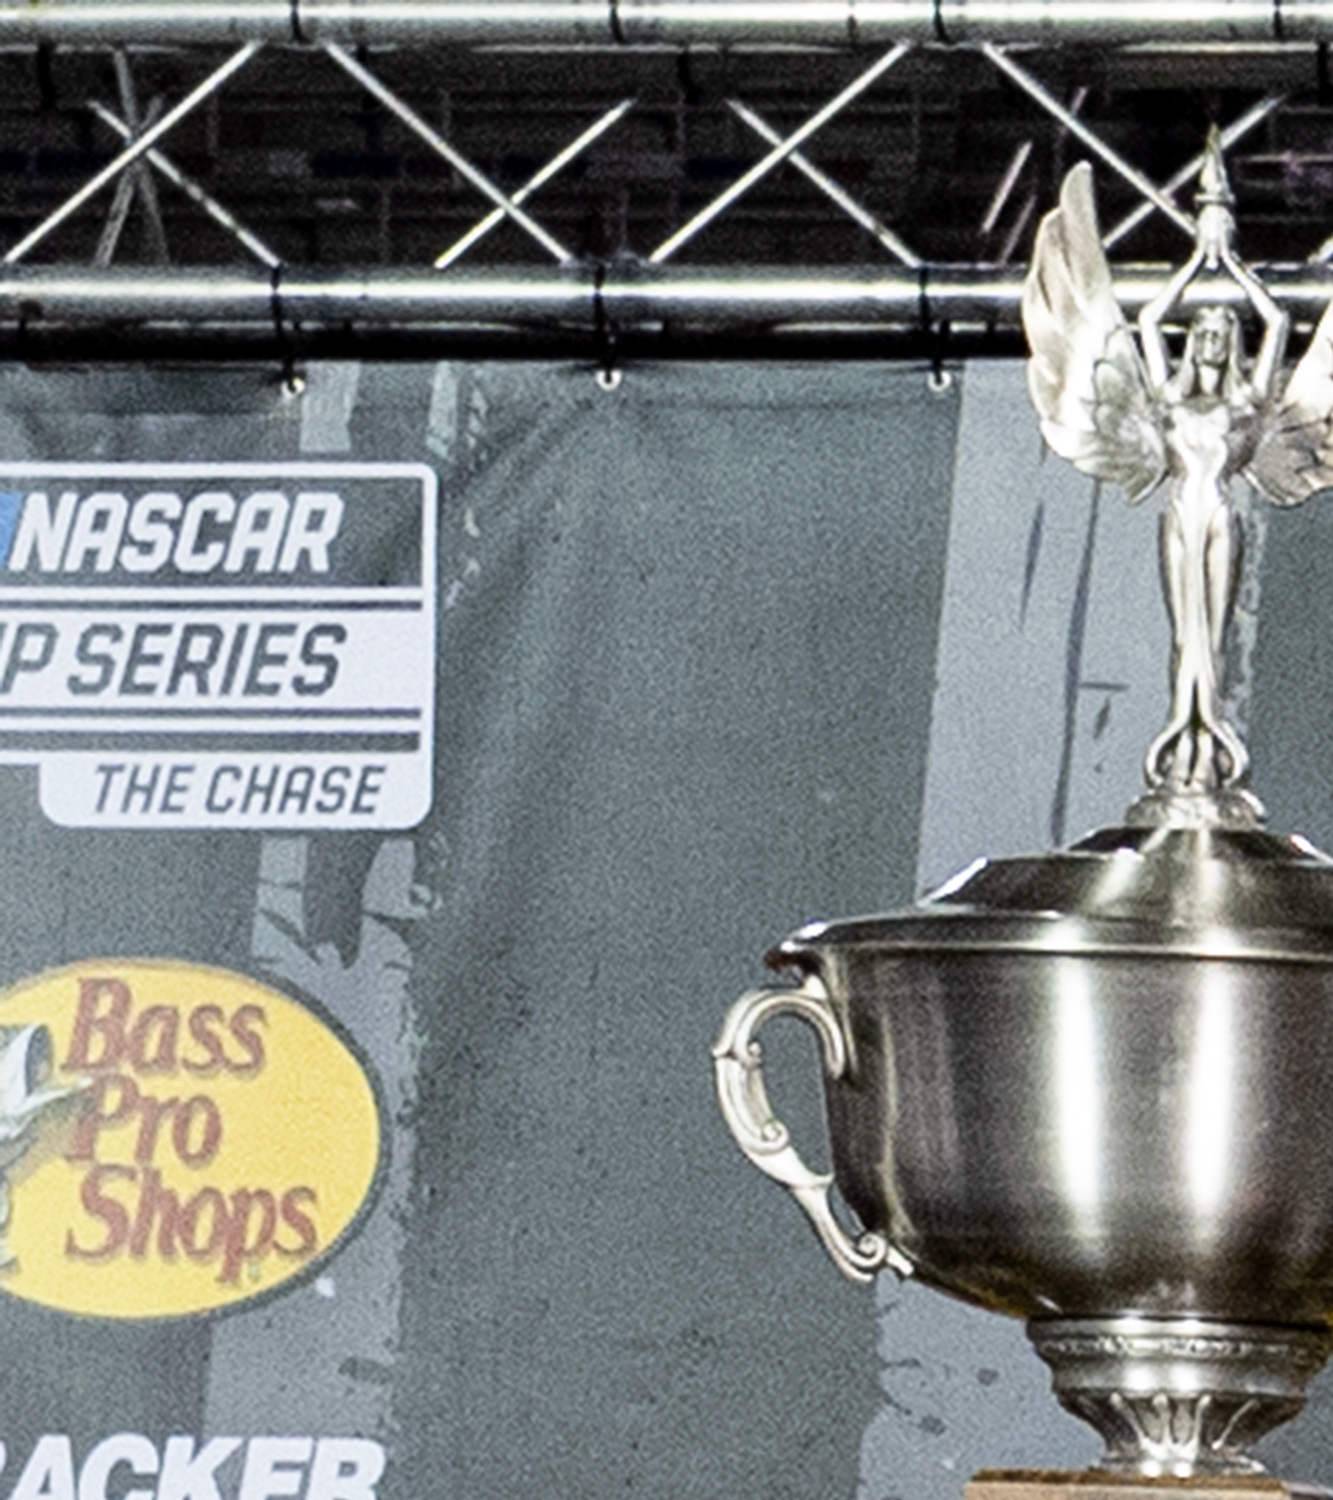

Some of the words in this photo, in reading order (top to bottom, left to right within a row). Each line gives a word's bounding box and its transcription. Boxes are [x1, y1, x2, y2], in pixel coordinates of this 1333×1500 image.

[8, 491, 345, 573] NASCAR
[66, 622, 348, 697] SERIES
[95, 764, 195, 814] THE
[204, 764, 387, 814] CHASE
[60, 975, 270, 1076] Bass
[64, 1072, 224, 1168] Pro
[63, 1162, 320, 1284] Shops
